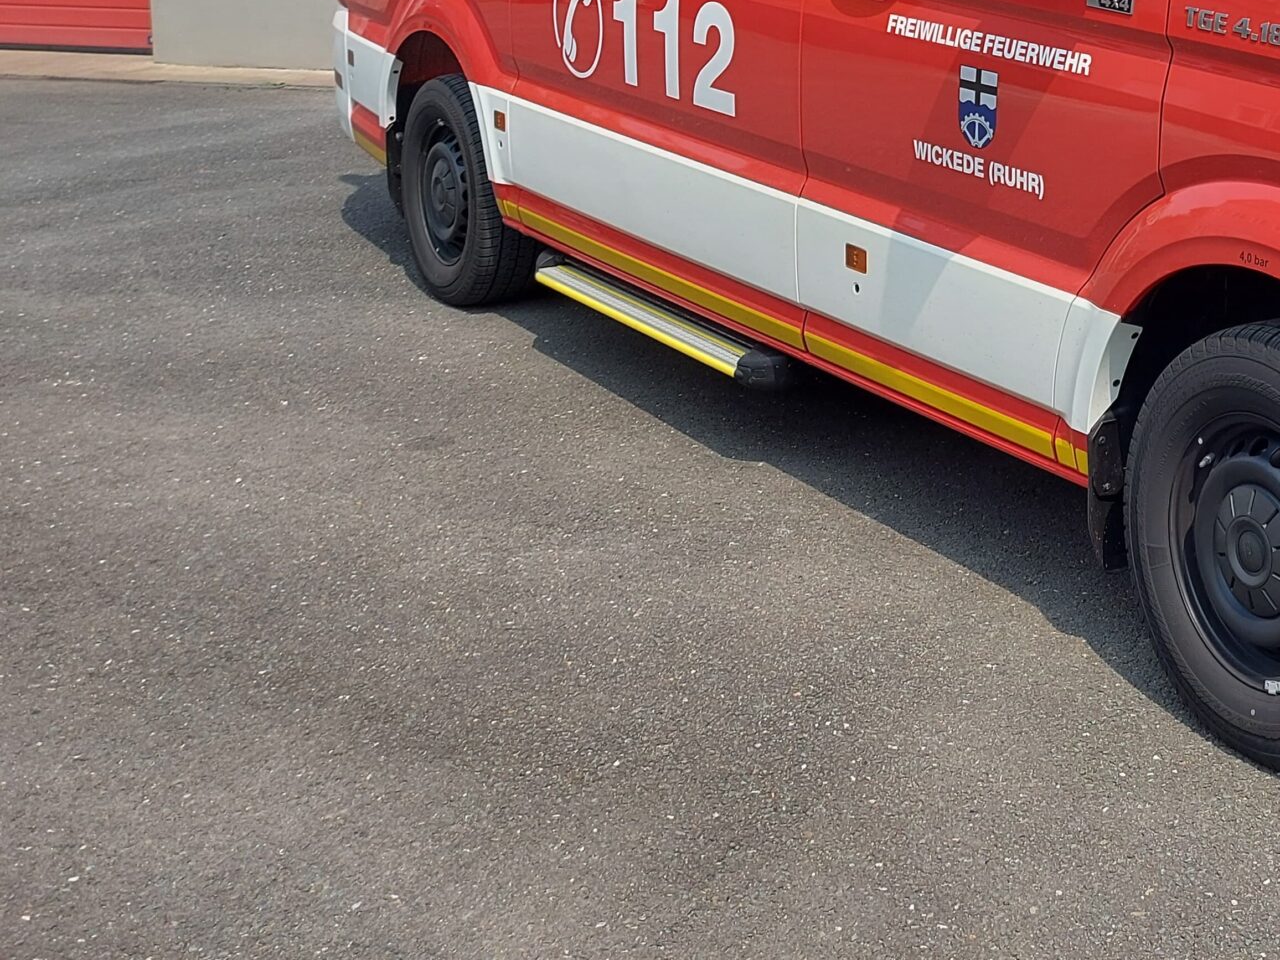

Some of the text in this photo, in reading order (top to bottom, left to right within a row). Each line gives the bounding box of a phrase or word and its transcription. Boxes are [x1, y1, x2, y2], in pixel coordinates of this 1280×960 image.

[1185, 6, 1229, 34] TGE
[886, 13, 1092, 76] FREIWILLIGE FEUERWEHR
[912, 140, 1044, 200] WICKEDE (RUHR)
[1239, 250, 1269, 267] 4,0 bar
